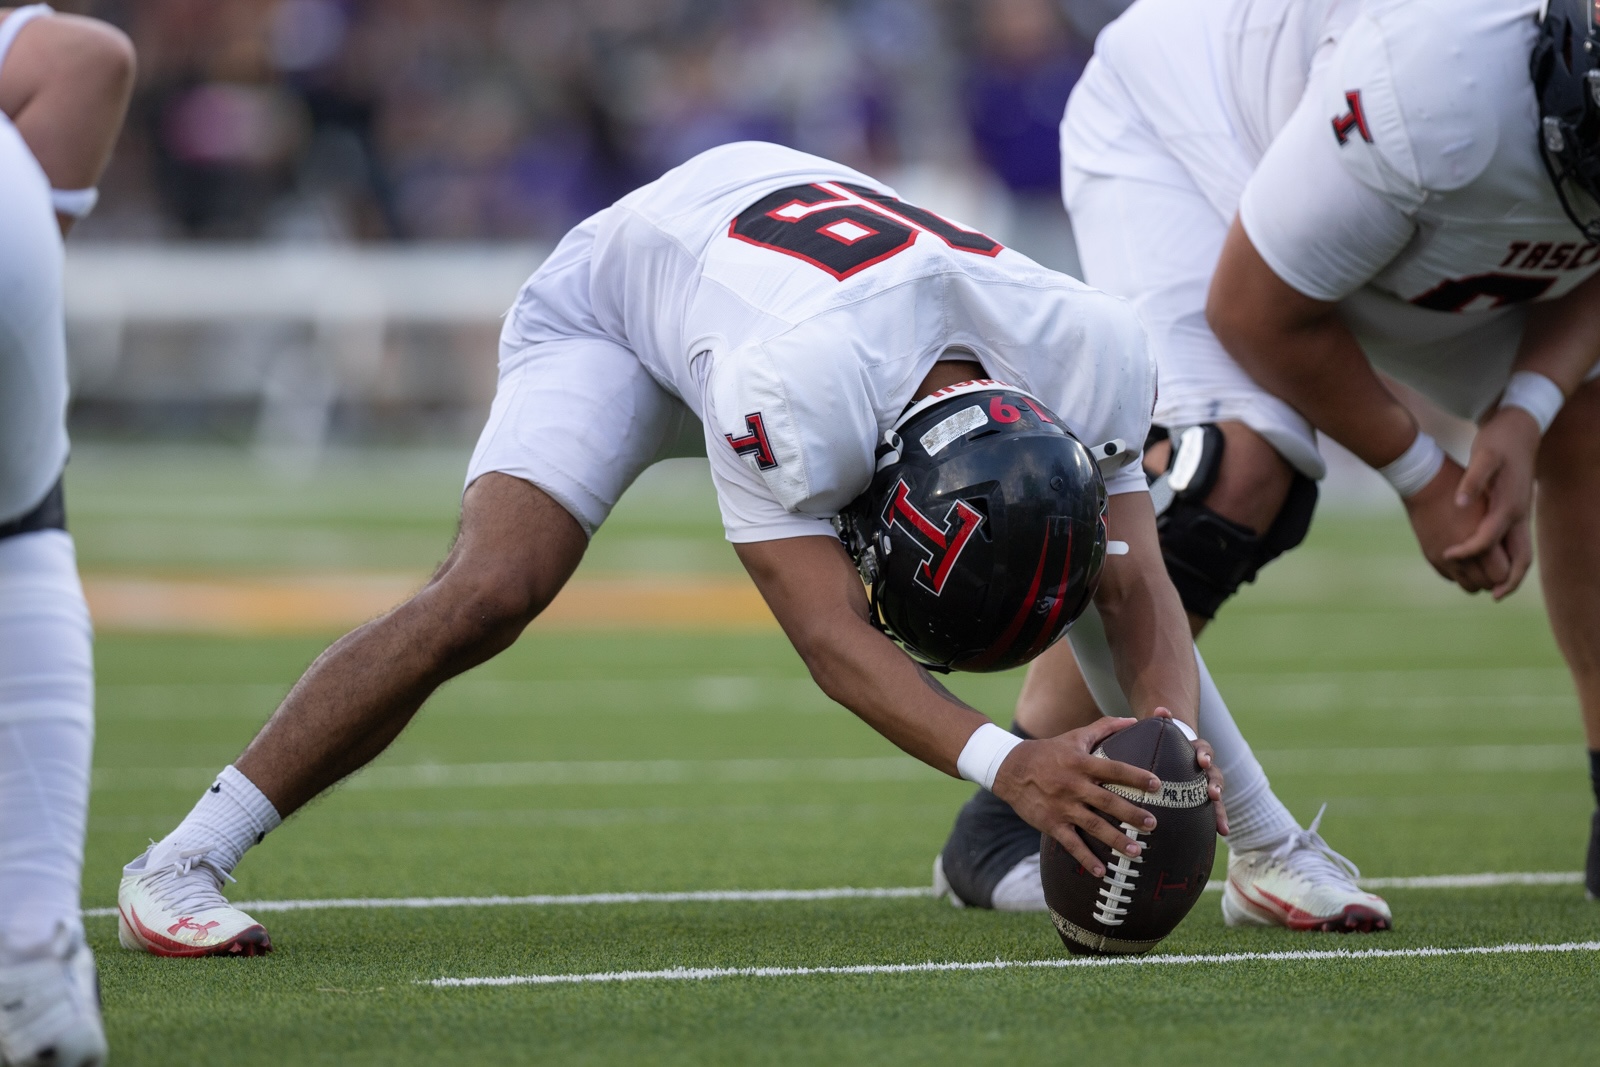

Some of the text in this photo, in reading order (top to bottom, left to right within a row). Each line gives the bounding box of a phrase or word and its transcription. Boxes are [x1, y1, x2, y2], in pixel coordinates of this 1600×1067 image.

[1331, 90, 1373, 146] T
[1499, 240, 1600, 270] TASC
[724, 412, 778, 471] T
[881, 478, 983, 597] T
